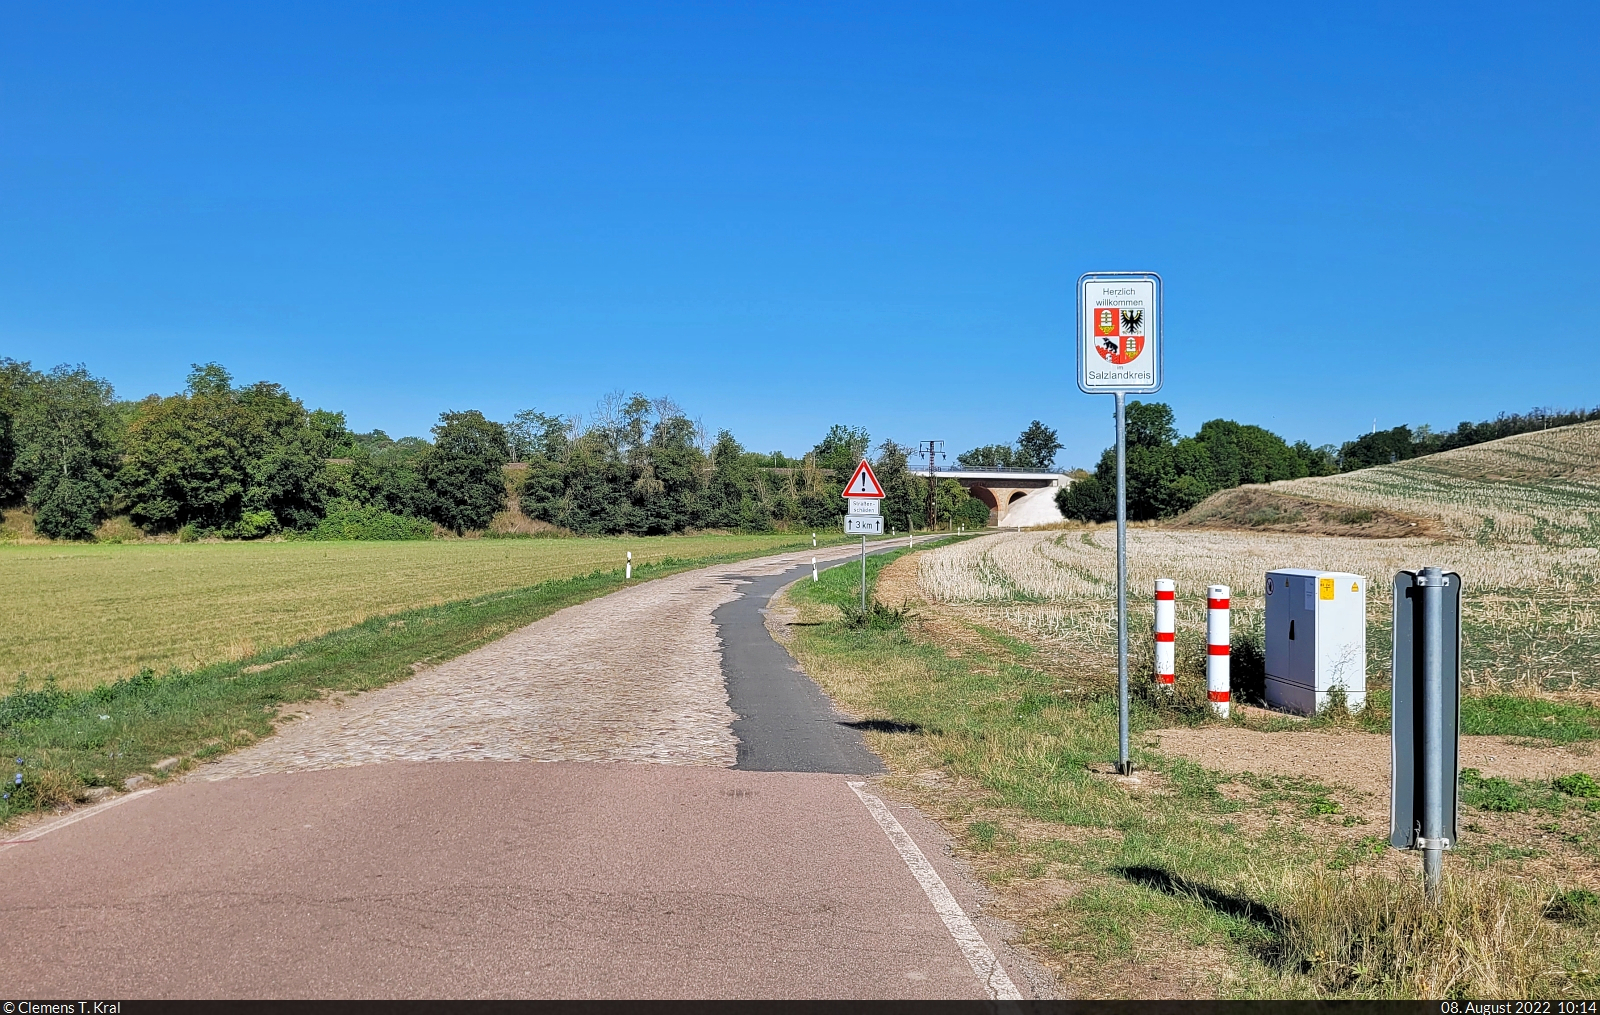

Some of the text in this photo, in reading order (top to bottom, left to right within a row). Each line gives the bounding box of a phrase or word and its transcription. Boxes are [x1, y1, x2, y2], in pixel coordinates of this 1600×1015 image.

[1102, 288, 1136, 296] Herzlich
[1095, 298, 1144, 307] willkommen
[1088, 370, 1151, 380] Salzlandkreis
[855, 520, 873, 530] 3 km
